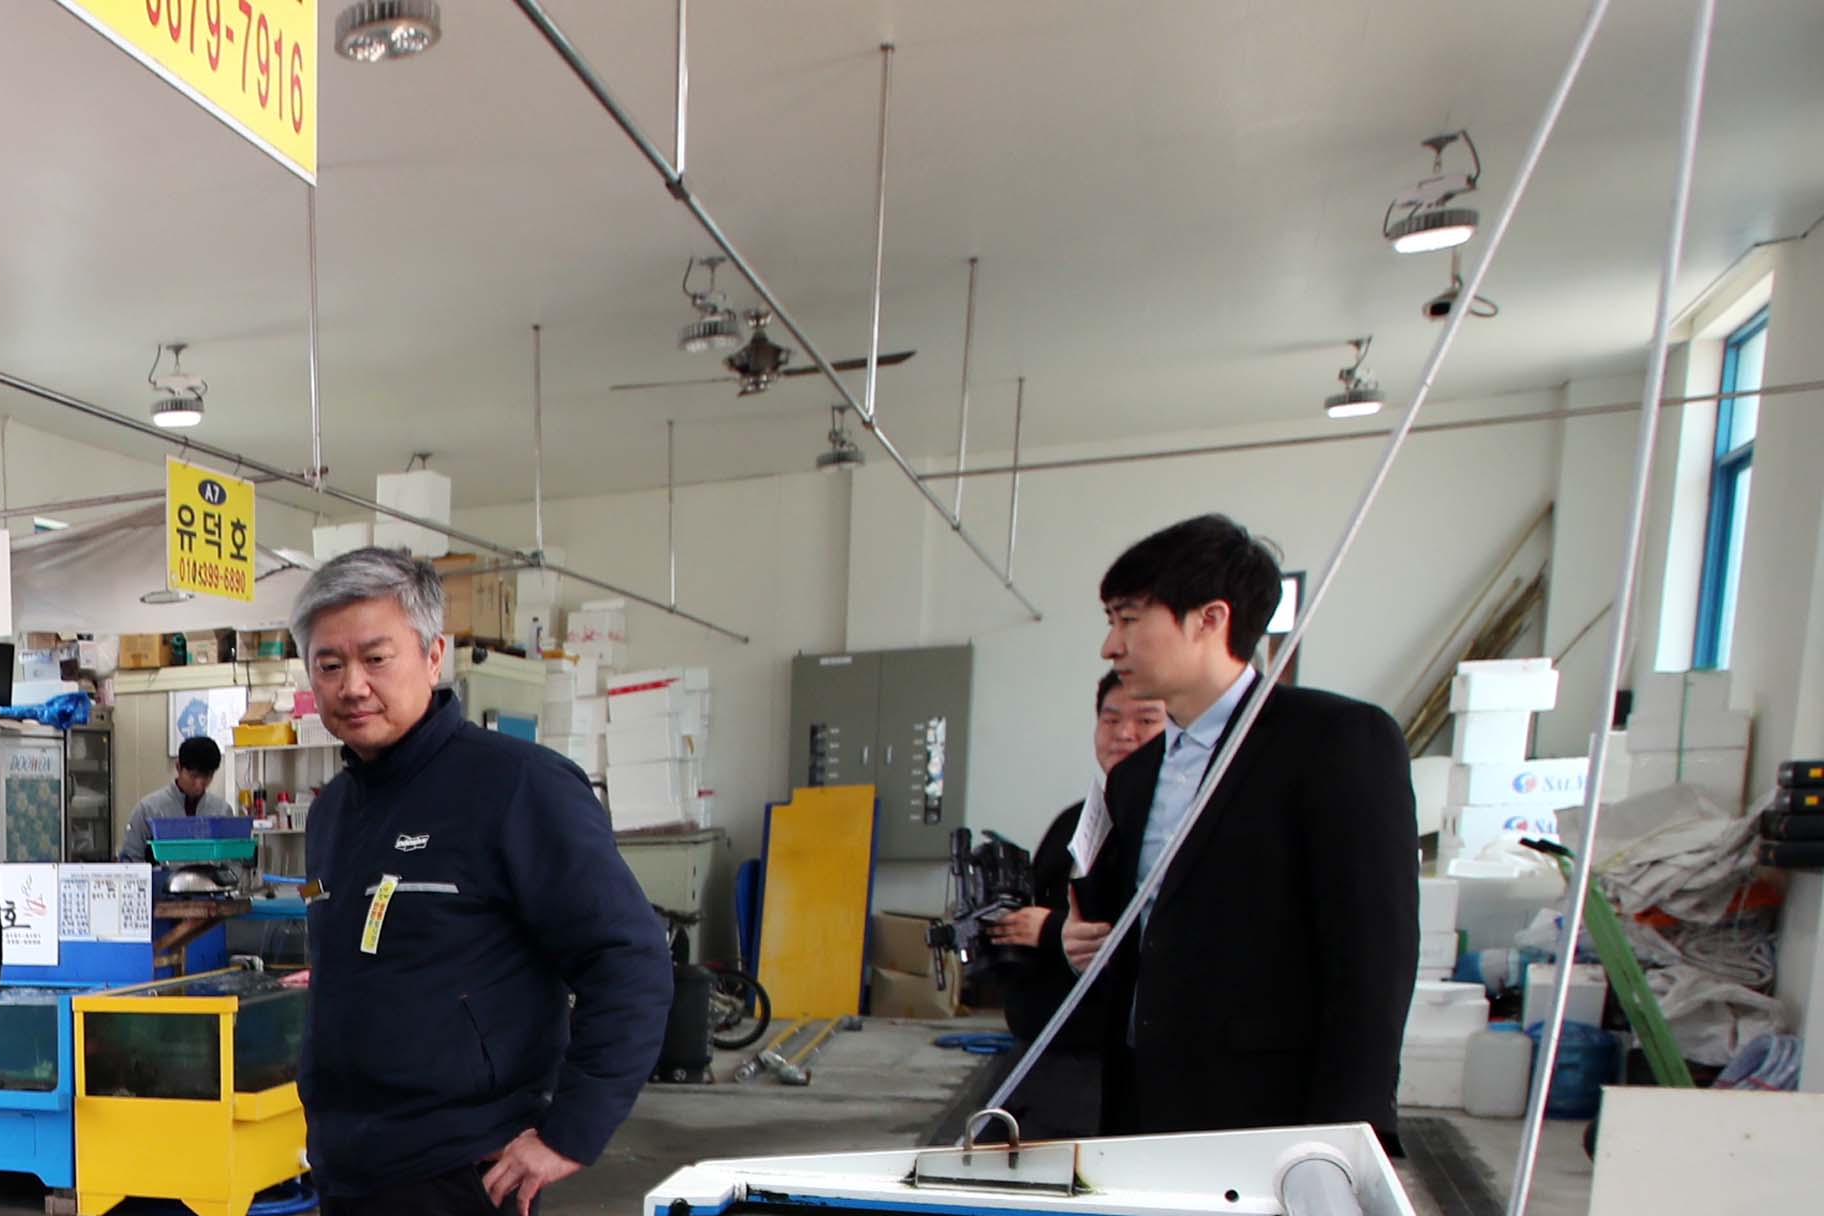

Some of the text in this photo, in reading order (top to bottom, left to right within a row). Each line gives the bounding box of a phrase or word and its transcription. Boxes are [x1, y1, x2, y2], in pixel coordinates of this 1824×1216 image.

[143, 0, 304, 135] 79-7916
[204, 482, 220, 503] A7
[176, 504, 248, 562] 유덕호
